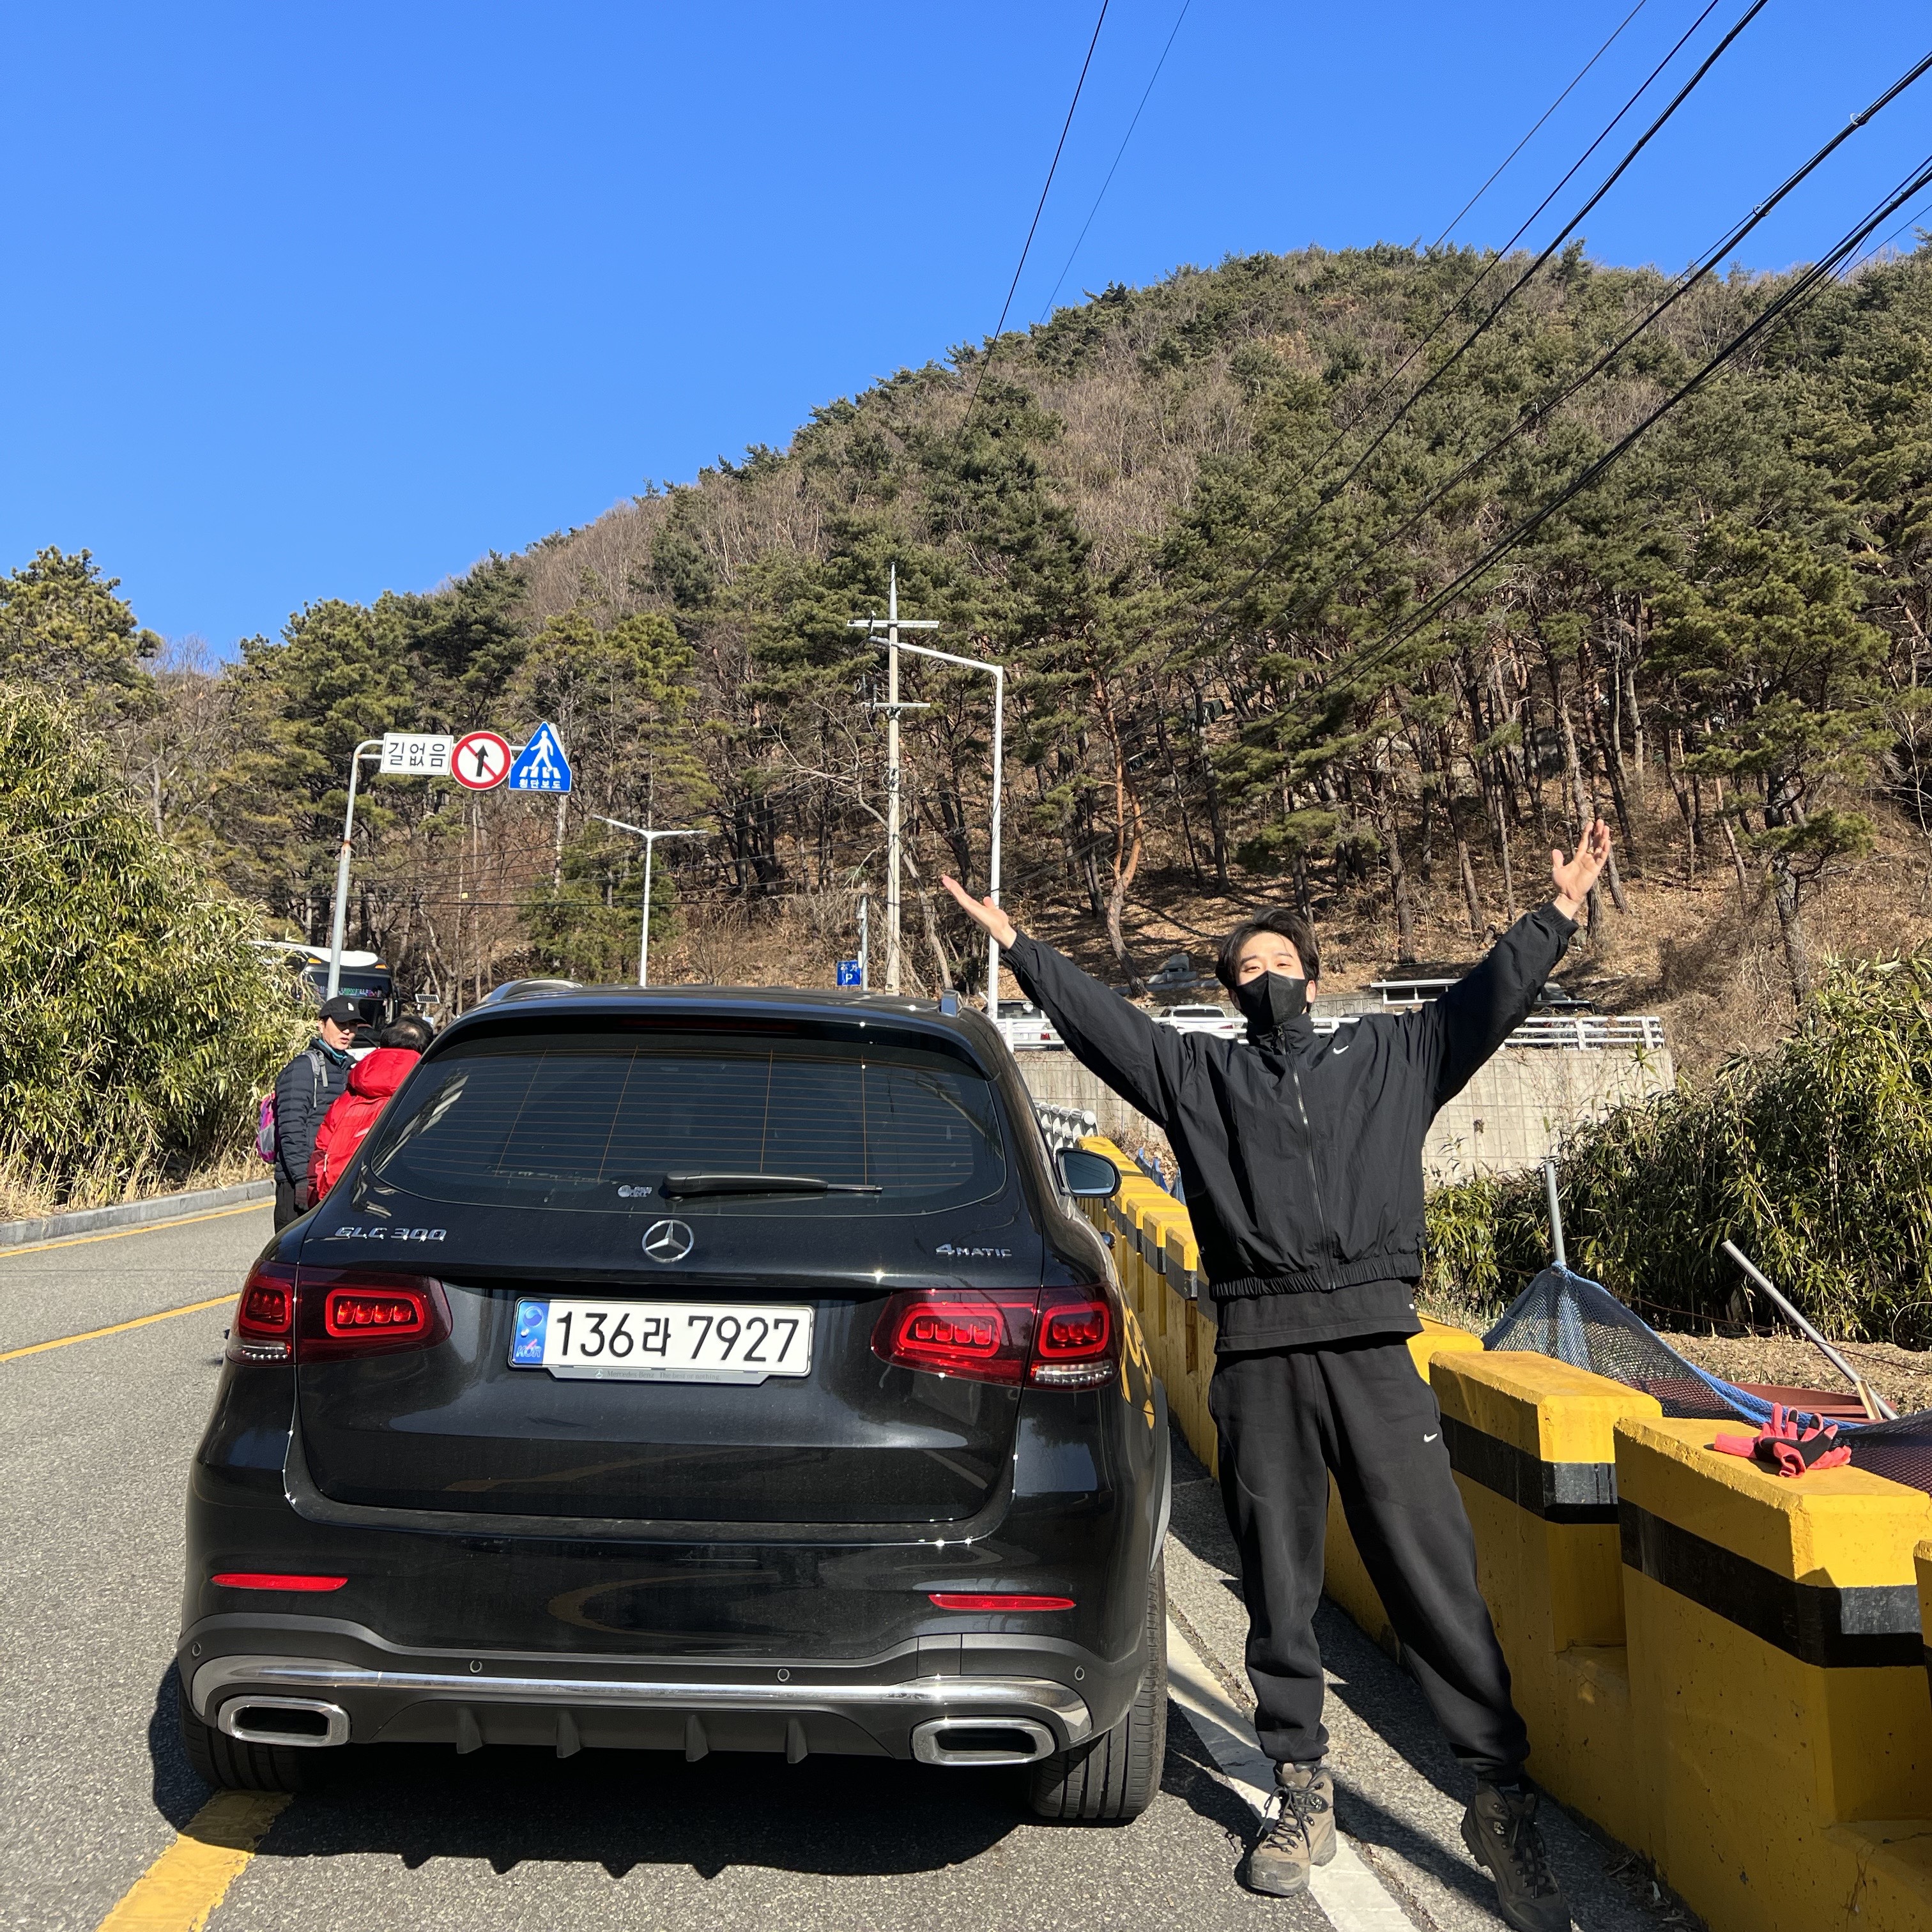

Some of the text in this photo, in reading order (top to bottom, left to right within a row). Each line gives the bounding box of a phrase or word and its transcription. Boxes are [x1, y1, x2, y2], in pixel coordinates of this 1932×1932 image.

[388, 742, 446, 767] 길없음
[846, 973, 853, 983] P
[335, 1226, 447, 1242] GLC 300
[935, 1243, 1013, 1257] 4MATIC
[556, 1311, 799, 1363] 136라 7927
